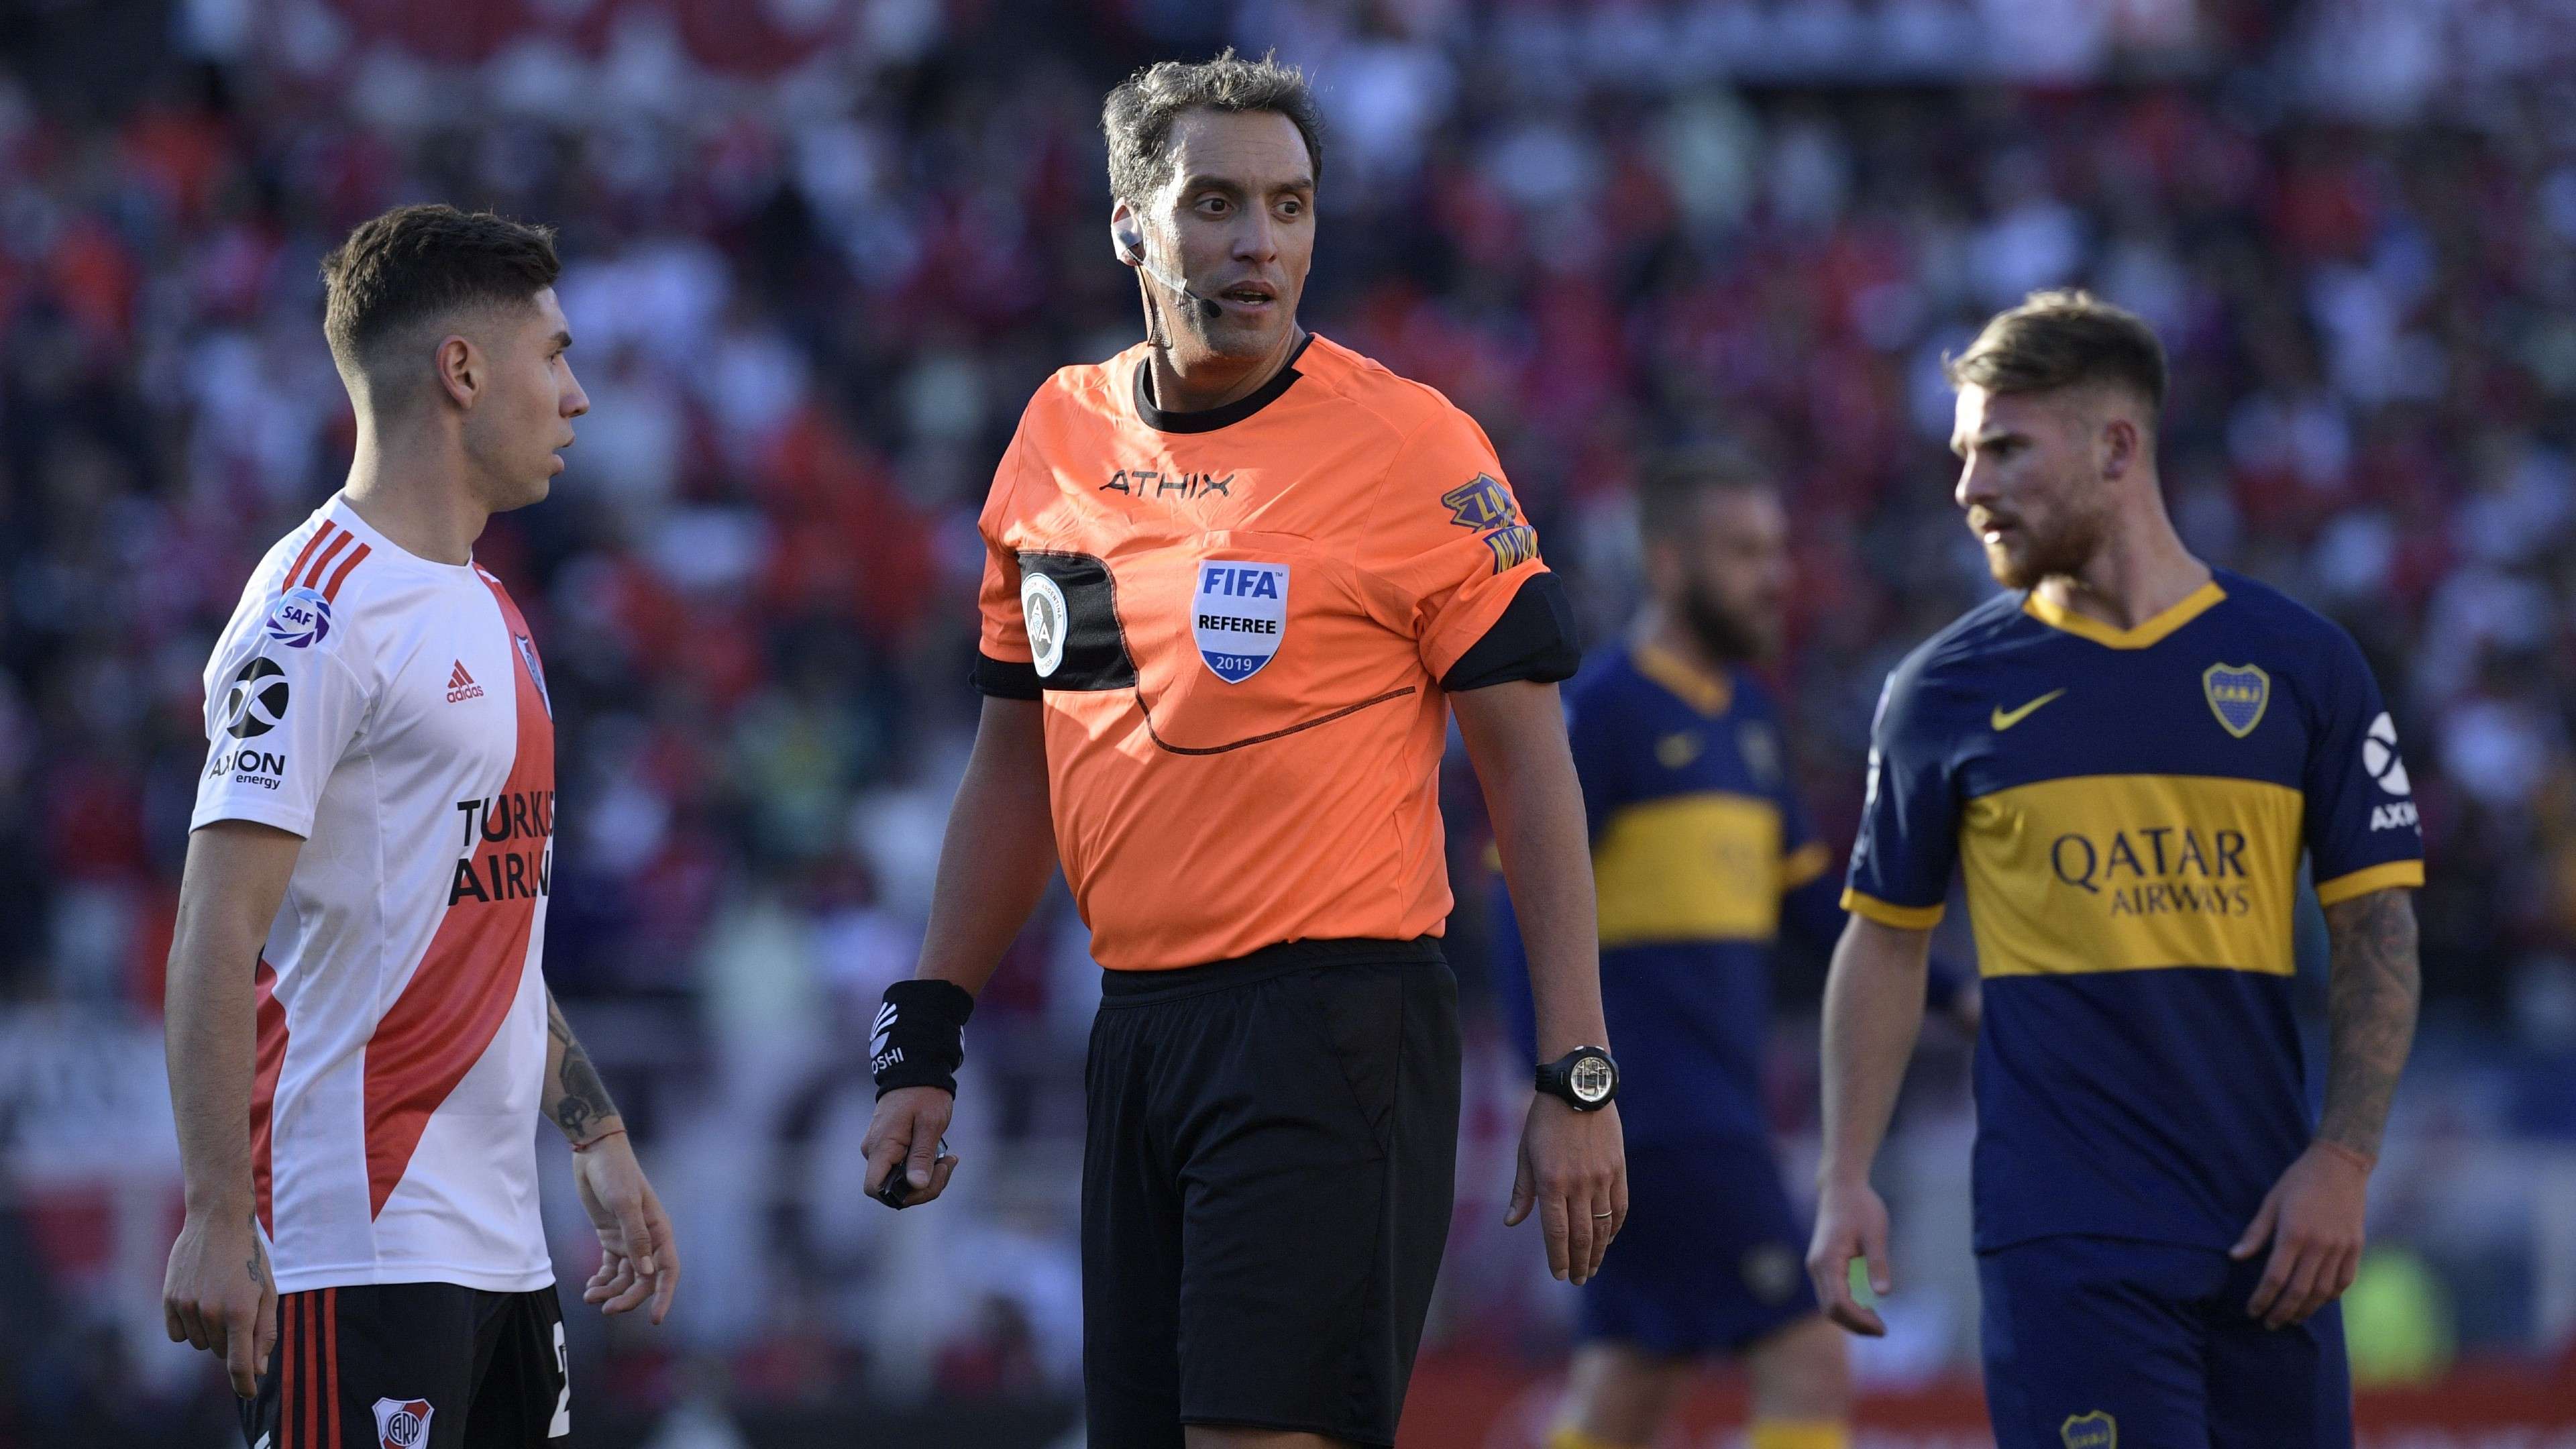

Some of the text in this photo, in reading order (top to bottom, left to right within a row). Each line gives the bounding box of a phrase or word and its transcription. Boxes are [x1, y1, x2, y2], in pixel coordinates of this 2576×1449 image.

[1099, 470, 1234, 498] ATHIX
[1203, 568, 1278, 599] FIFA
[282, 606, 313, 625] SAF
[1199, 614, 1277, 634] REFEREE
[1216, 656, 1252, 672] 2019
[447, 684, 484, 703] adidas
[209, 750, 285, 779] AXION
[235, 775, 280, 790] energy
[2051, 826, 2247, 894] QATAR
[2110, 883, 2249, 918] AIRWAYS
